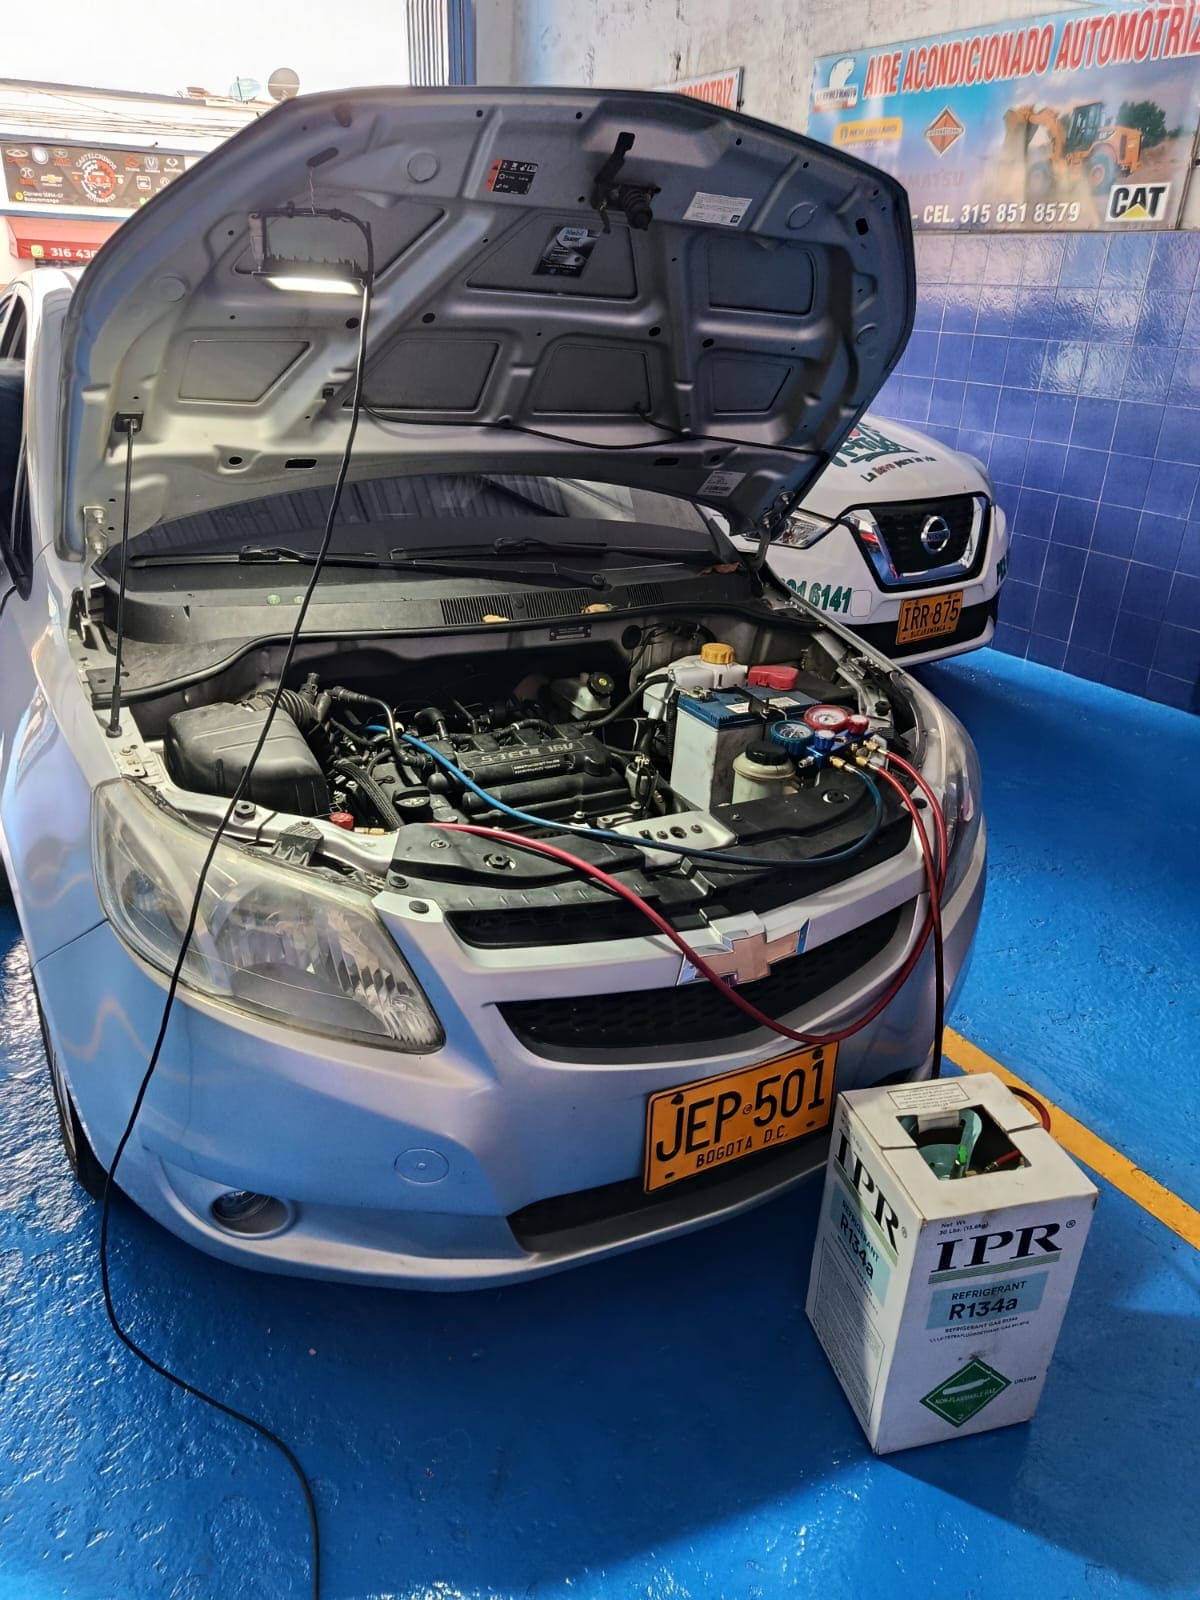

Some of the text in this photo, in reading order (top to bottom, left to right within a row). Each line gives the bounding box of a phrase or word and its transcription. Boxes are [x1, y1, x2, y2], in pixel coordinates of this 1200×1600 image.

[863, 52, 902, 98] AIRE
[902, 23, 1055, 93] ACONDICIONADO
[672, 76, 734, 110] MOTRIZ
[923, 205, 955, 224] CEL.
[960, 204, 991, 223] 315
[996, 202, 1027, 222] 851
[1033, 201, 1081, 223] 8579
[1109, 186, 1167, 219] CAT
[50, 247, 72, 258] 316
[809, 582, 852, 613] 6141
[902, 599, 961, 632] IRR 875
[656, 1059, 825, 1162] JEP 501
[696, 1125, 788, 1168] BOGOTA D.C.
[834, 1128, 899, 1256] IPR
[840, 1213, 874, 1280] R134a
[930, 1223, 1063, 1273] IPR
[951, 1281, 1027, 1300] REFRIGERANT
[948, 1298, 1018, 1320] R134a
